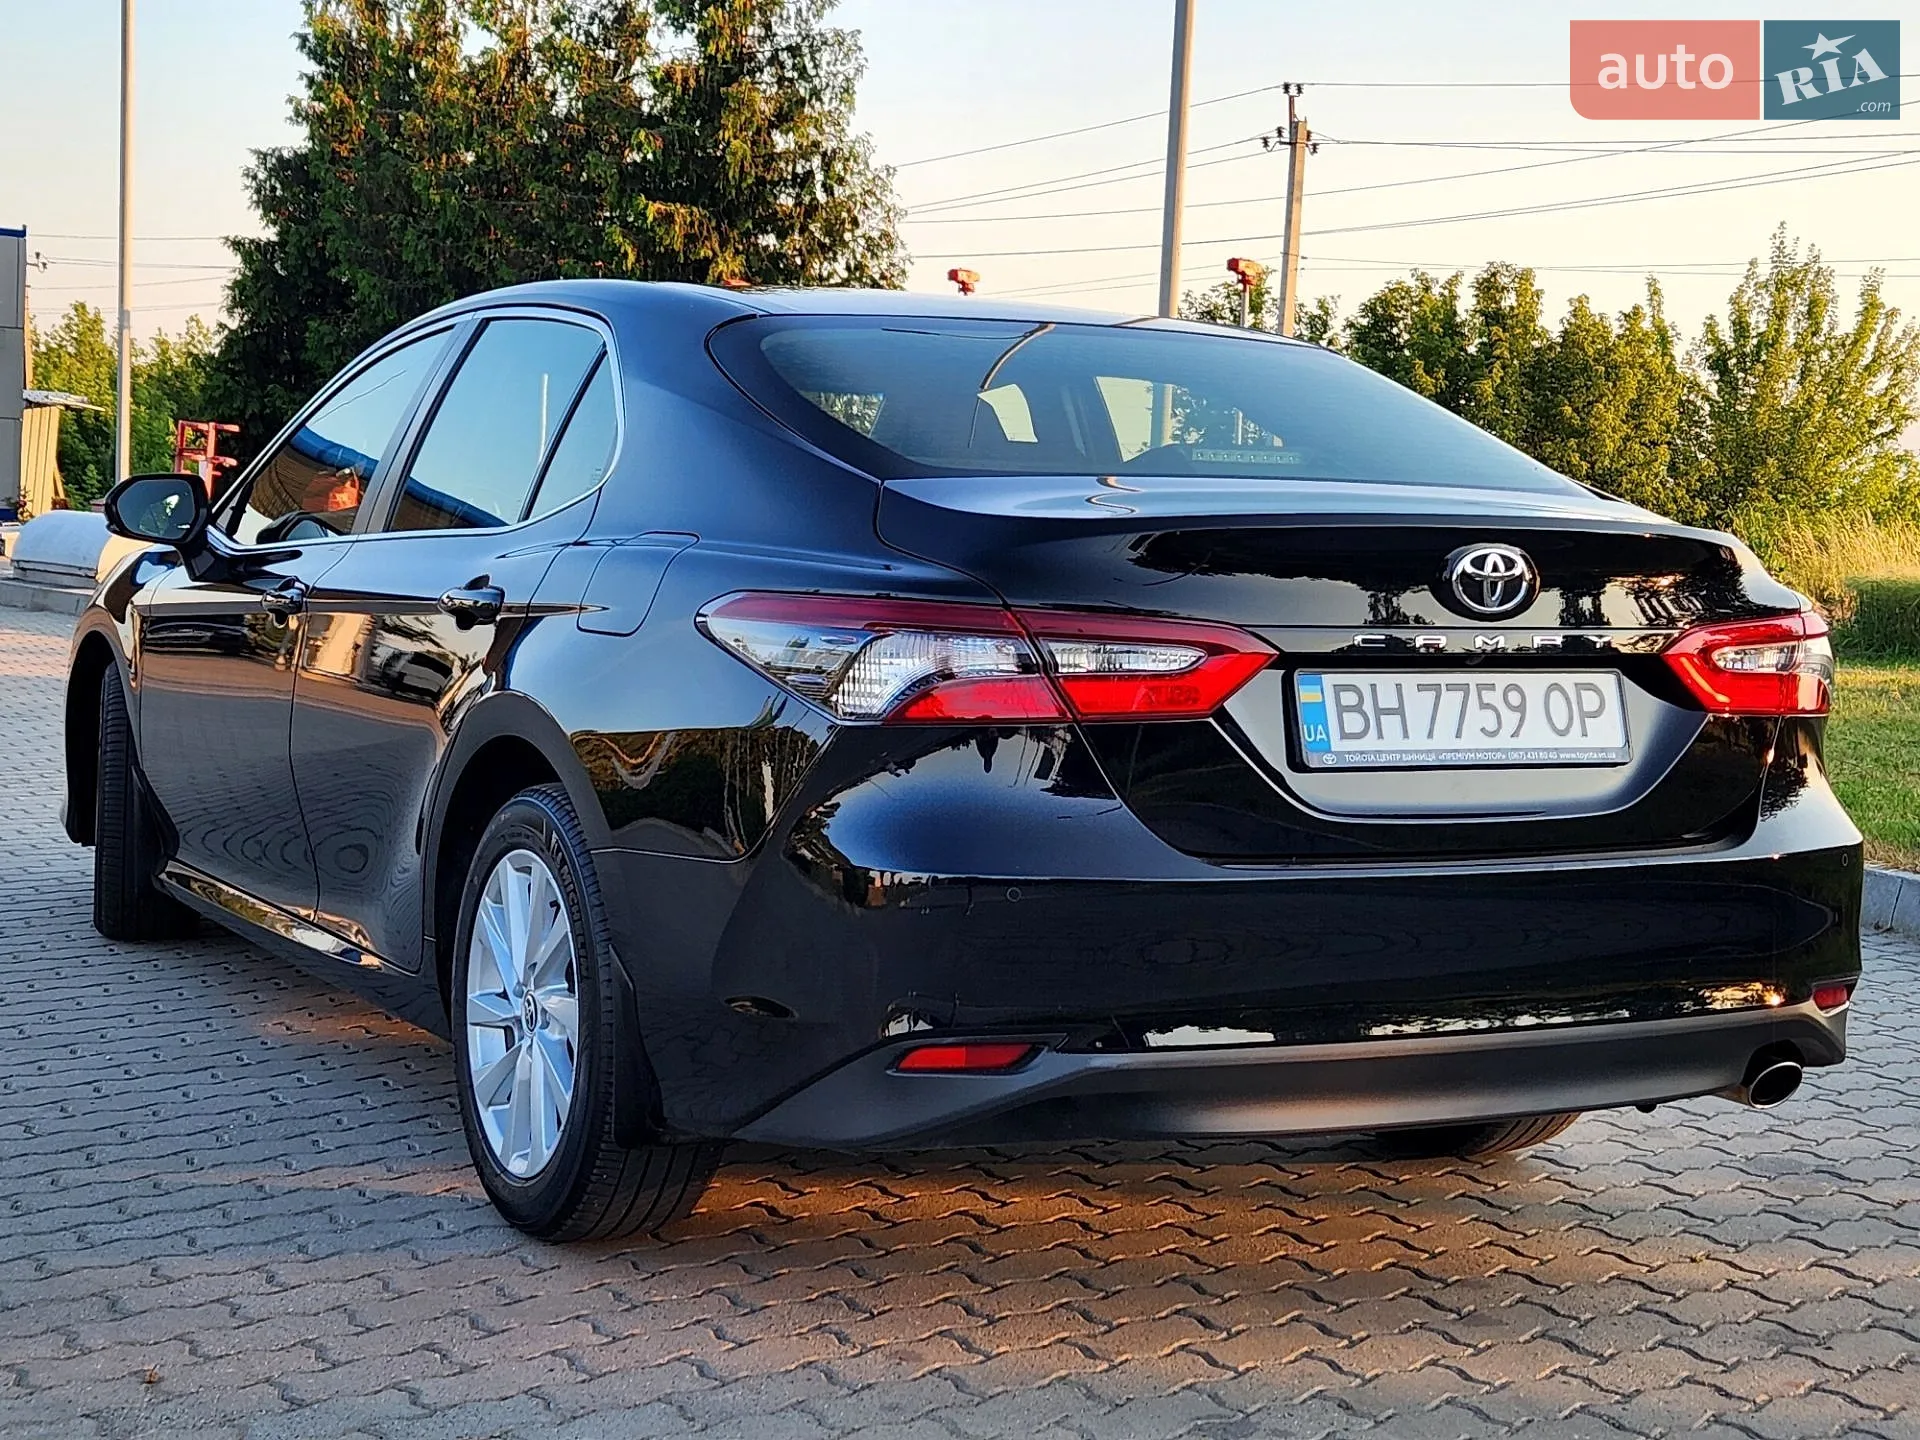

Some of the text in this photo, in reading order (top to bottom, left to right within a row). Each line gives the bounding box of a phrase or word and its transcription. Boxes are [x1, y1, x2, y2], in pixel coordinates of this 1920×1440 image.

[1353, 633, 1612, 650] CAMRY
[1332, 681, 1606, 741] BH 7759 OP
[1303, 723, 1328, 743] UA
